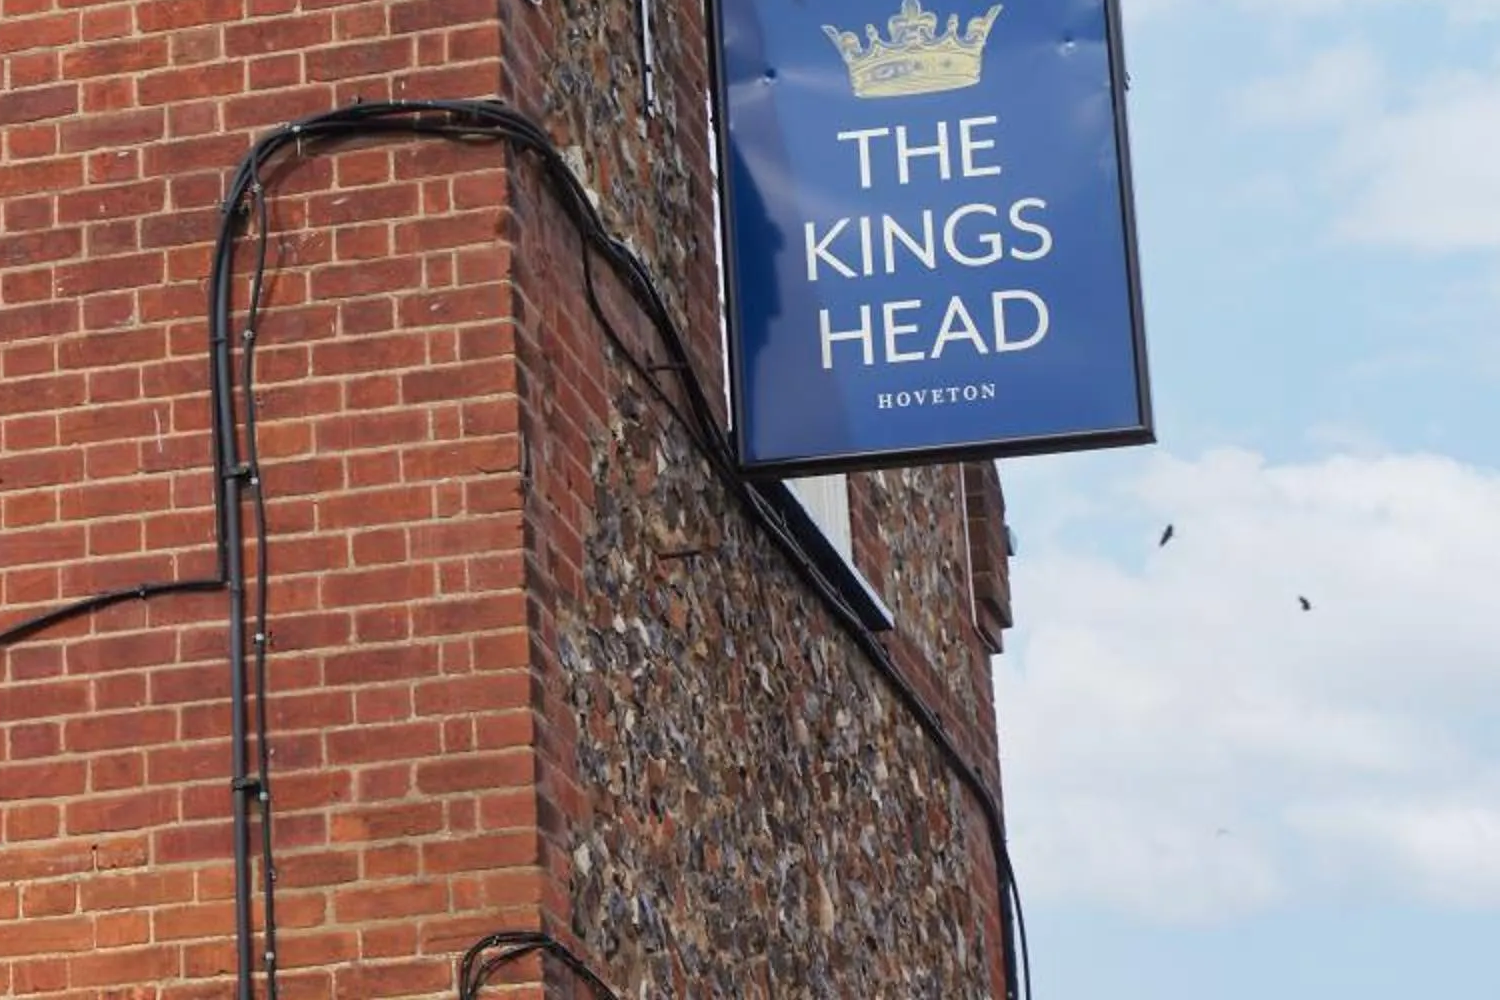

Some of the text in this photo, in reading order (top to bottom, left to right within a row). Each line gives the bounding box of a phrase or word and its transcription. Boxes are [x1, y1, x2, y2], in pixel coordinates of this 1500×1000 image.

[837, 115, 1001, 189] THE
[804, 197, 1053, 281] KINGS
[819, 289, 1049, 369] HEAD
[877, 382, 996, 409] HOVETON
